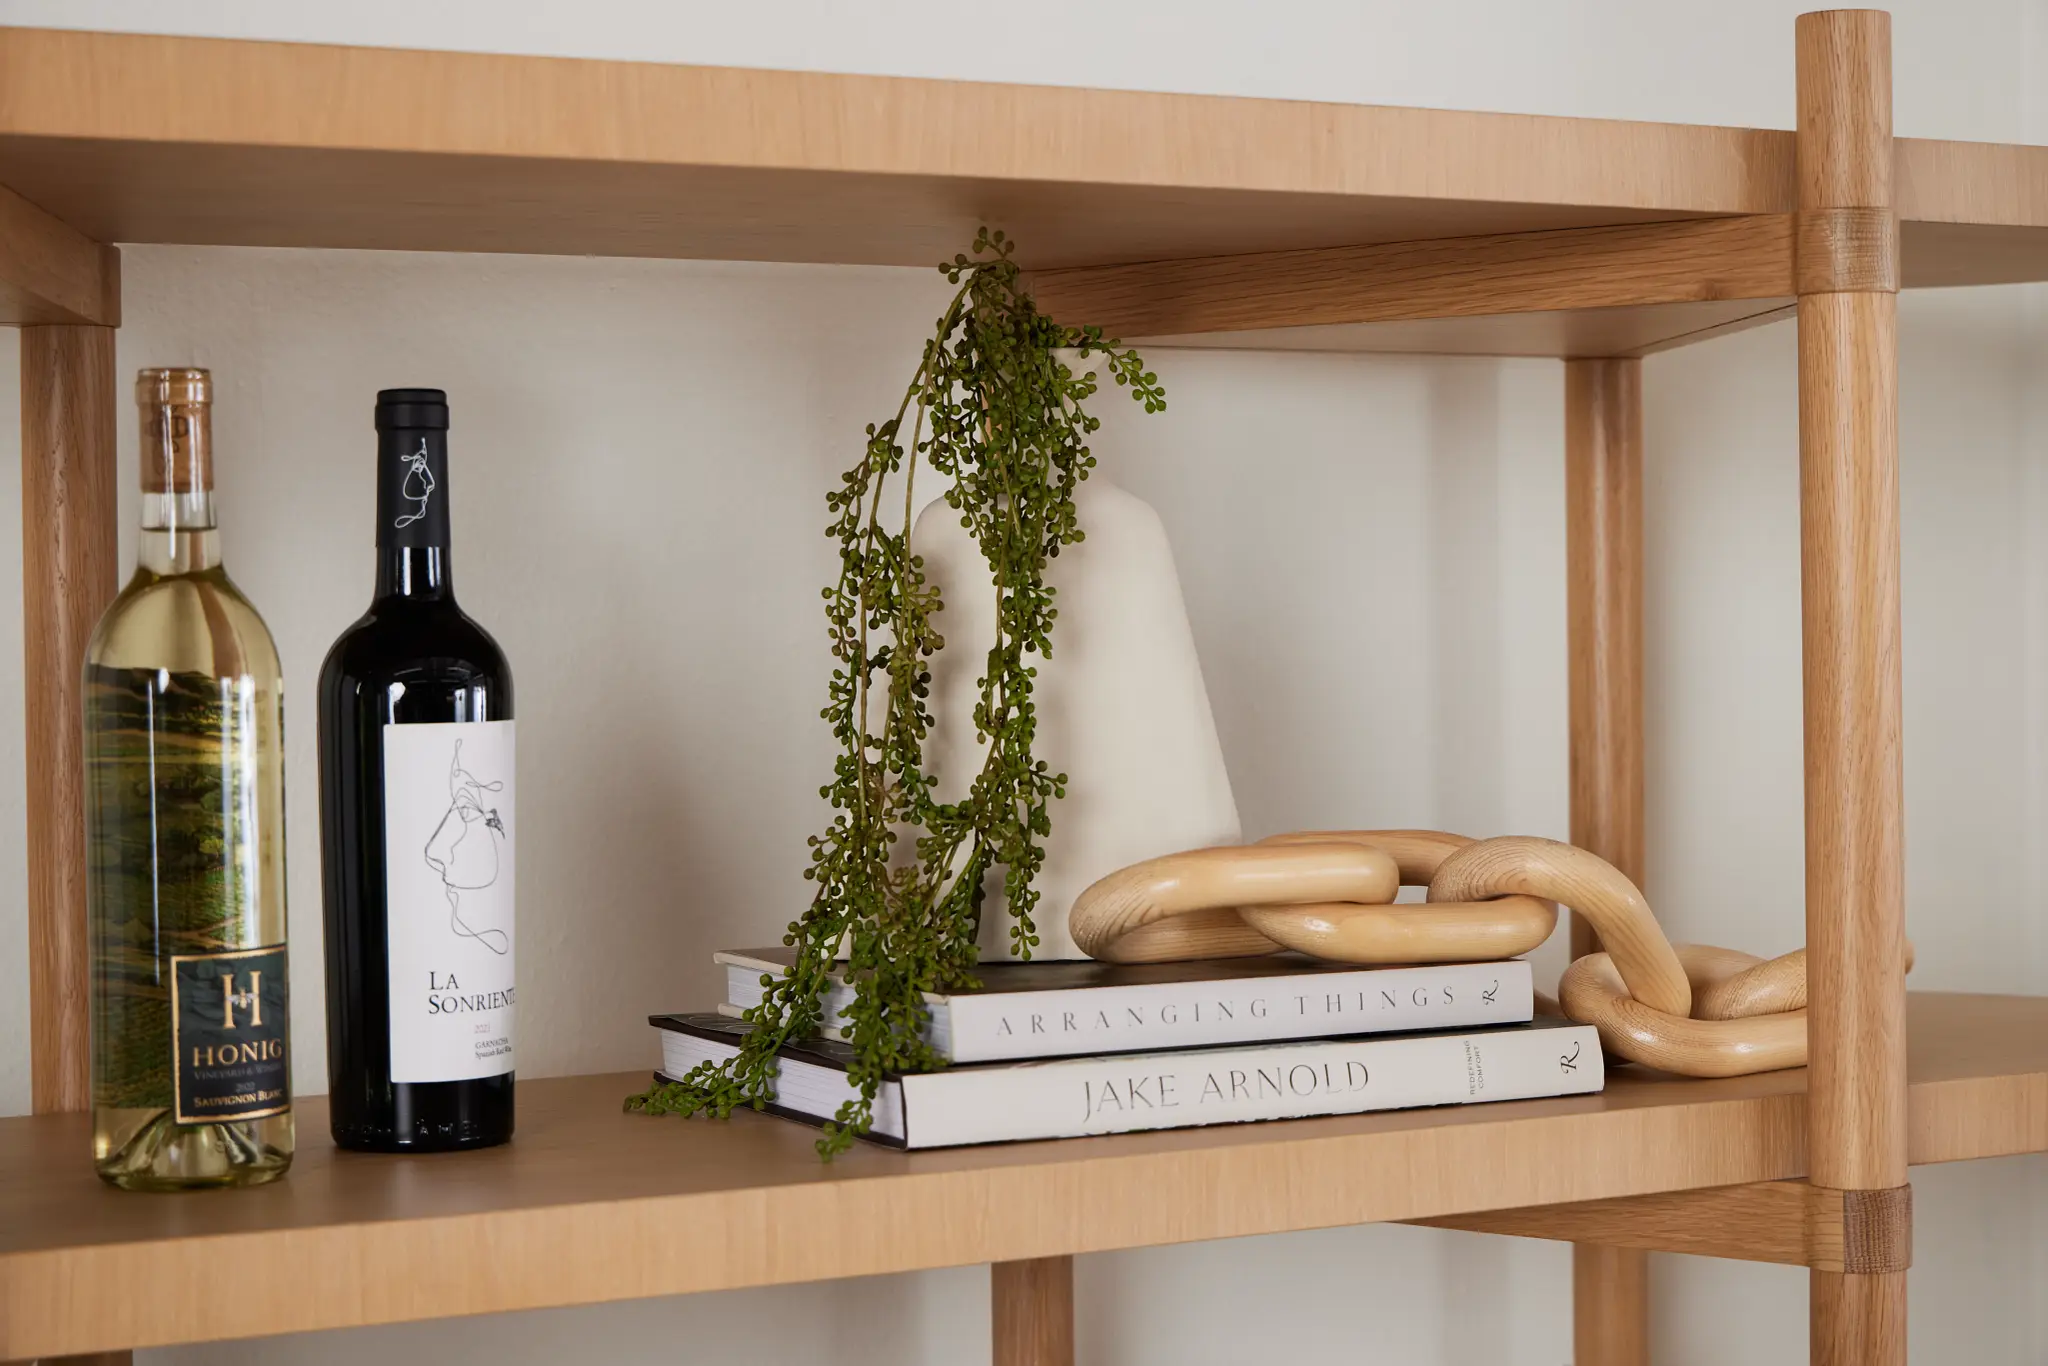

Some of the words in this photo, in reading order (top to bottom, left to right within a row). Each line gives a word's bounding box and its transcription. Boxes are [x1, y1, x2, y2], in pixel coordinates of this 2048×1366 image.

[429, 971, 459, 990] LA
[997, 999, 1267, 1035] ARRANGING
[1294, 986, 1454, 1015] THINGS
[193, 1038, 282, 1067] HONIG
[1464, 1040, 1476, 1095] REDEFINING
[1473, 1046, 1484, 1089] COMFORT
[194, 1093, 257, 1108] SAUVIGNON
[1083, 1075, 1179, 1122] JAKE
[1200, 1061, 1368, 1104] ARNOLD
